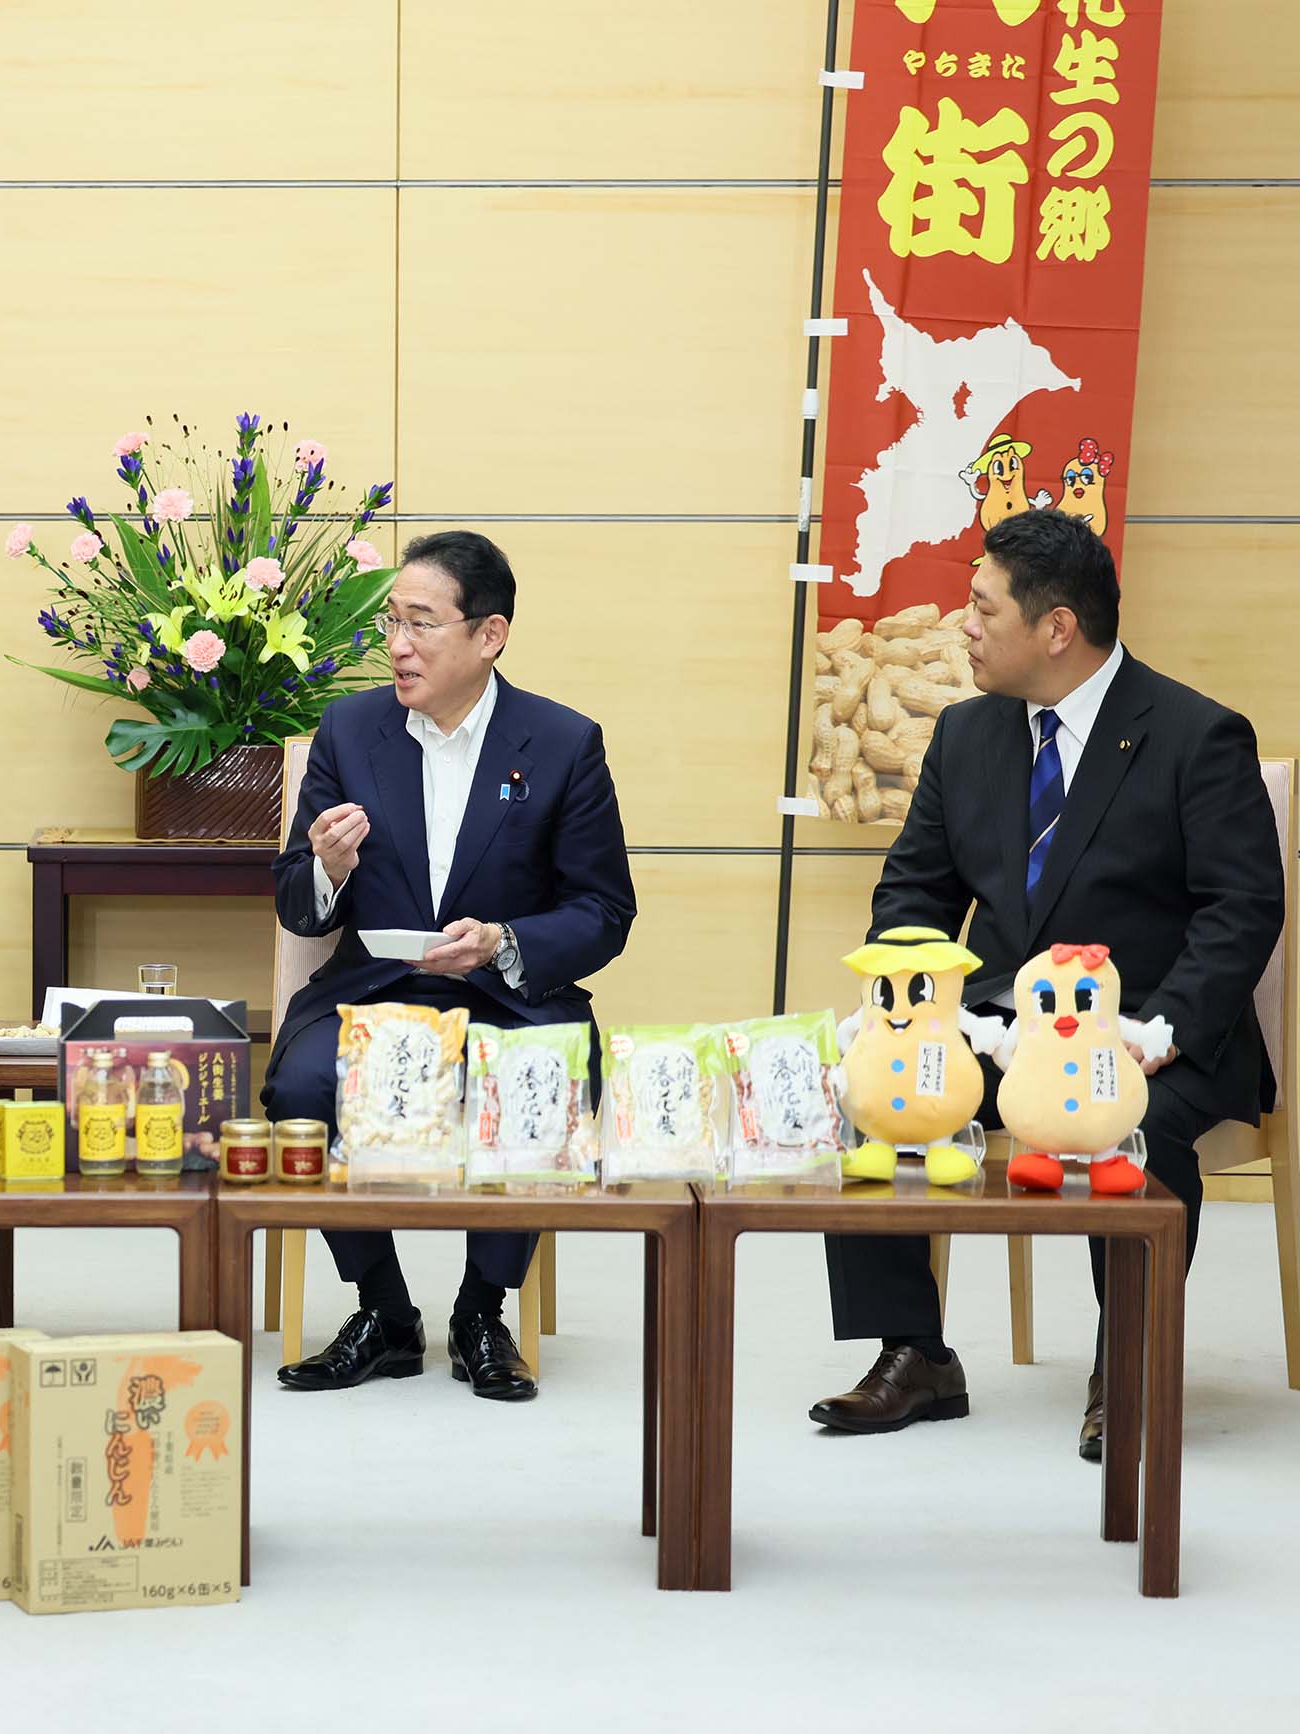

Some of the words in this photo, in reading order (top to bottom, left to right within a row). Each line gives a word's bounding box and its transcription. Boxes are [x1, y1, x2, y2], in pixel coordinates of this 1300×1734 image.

[903, 50, 1026, 80] やちまた
[198, 1052, 210, 1125] ジンジャーエール
[104, 1408, 132, 1507] にんじん
